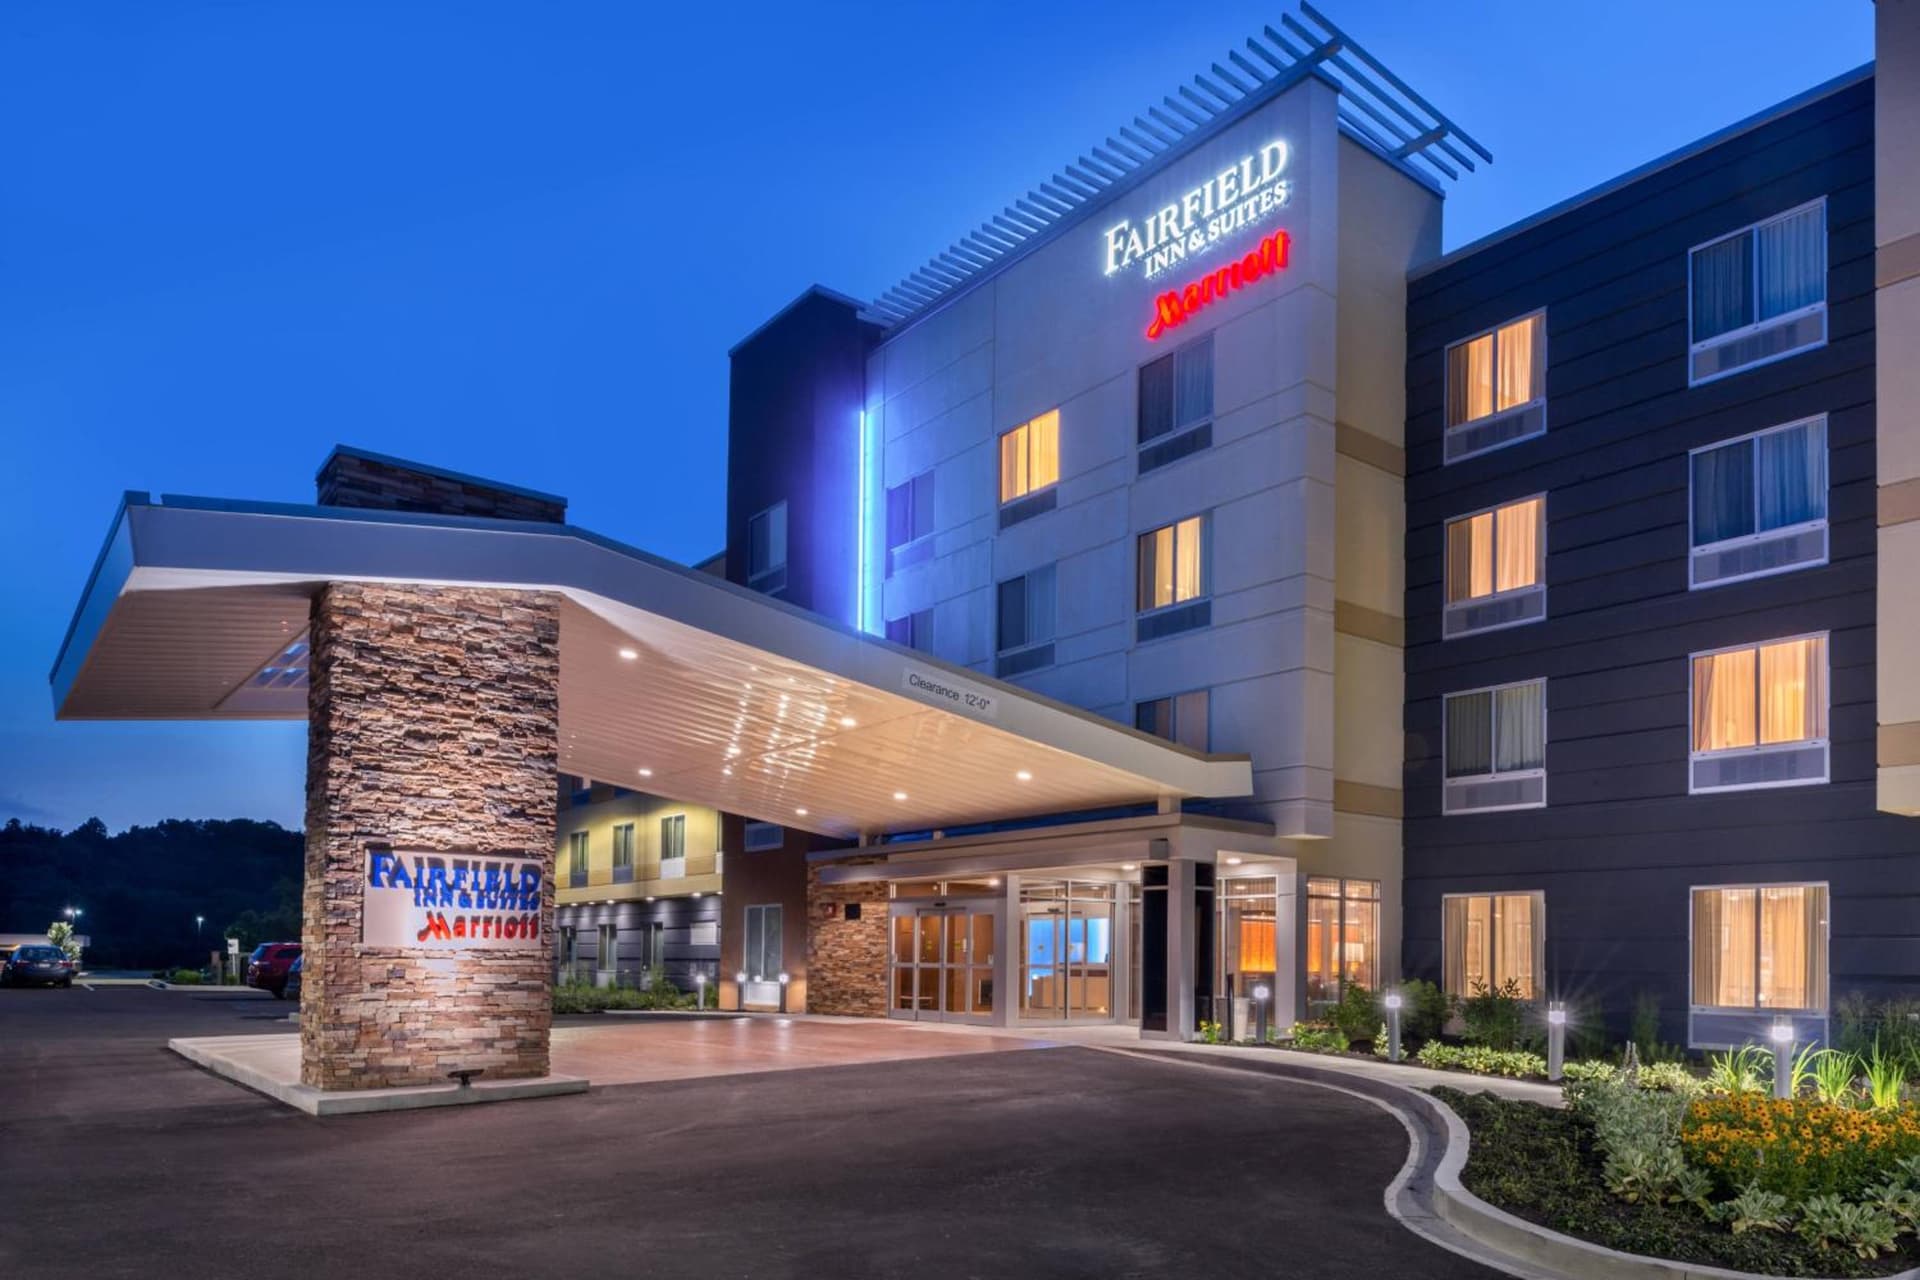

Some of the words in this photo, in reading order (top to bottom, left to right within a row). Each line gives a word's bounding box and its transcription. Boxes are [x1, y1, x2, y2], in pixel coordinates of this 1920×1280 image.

[1104, 139, 1289, 276] FAIRFIELD
[1145, 235, 1187, 279] INN
[1207, 178, 1288, 241] SUITES
[1146, 229, 1290, 338] Marriott
[909, 673, 959, 701] Clearance
[370, 850, 541, 893] FAIRFIELD
[417, 911, 540, 941] Marriott
